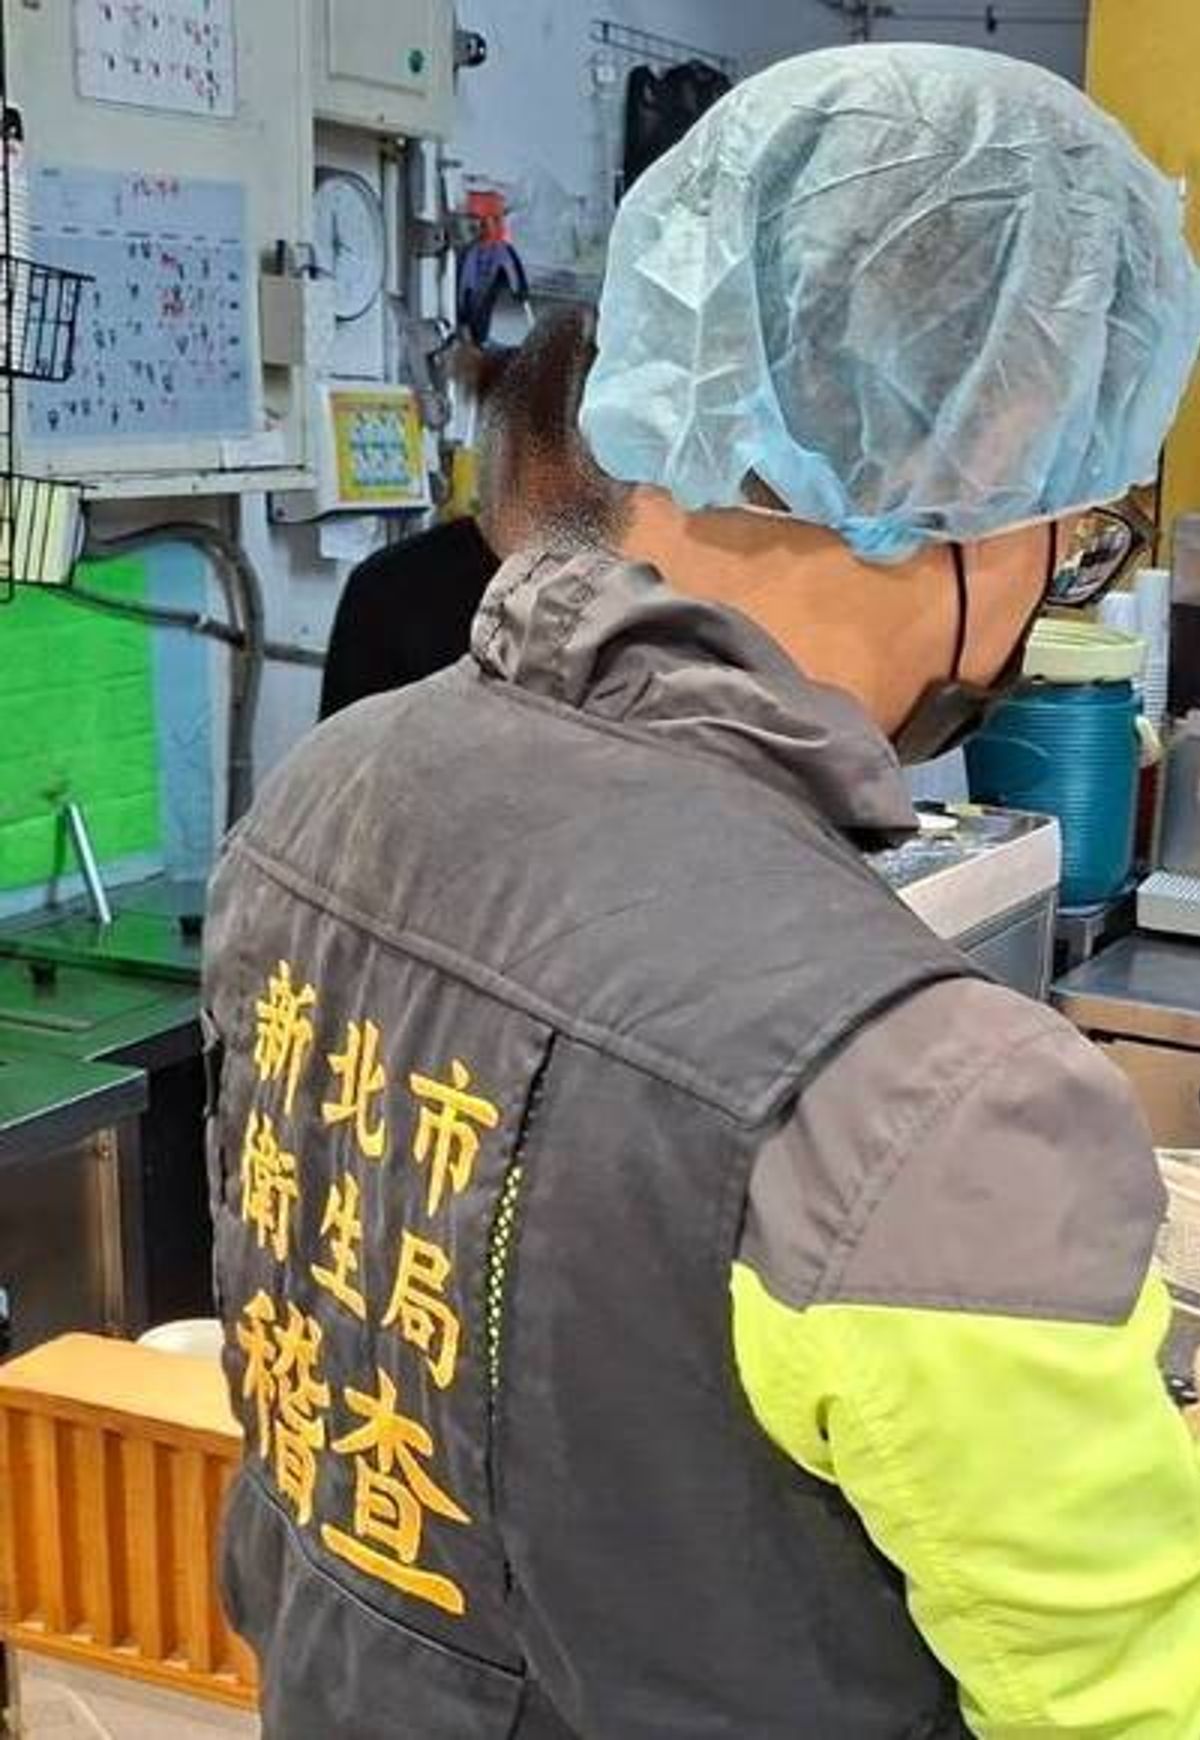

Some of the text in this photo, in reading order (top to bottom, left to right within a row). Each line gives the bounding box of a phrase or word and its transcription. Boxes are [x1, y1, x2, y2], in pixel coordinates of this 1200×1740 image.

[254, 959, 500, 1218] 新北市
[241, 1108, 461, 1390] 衛生局
[237, 1288, 471, 1615] 稽查
